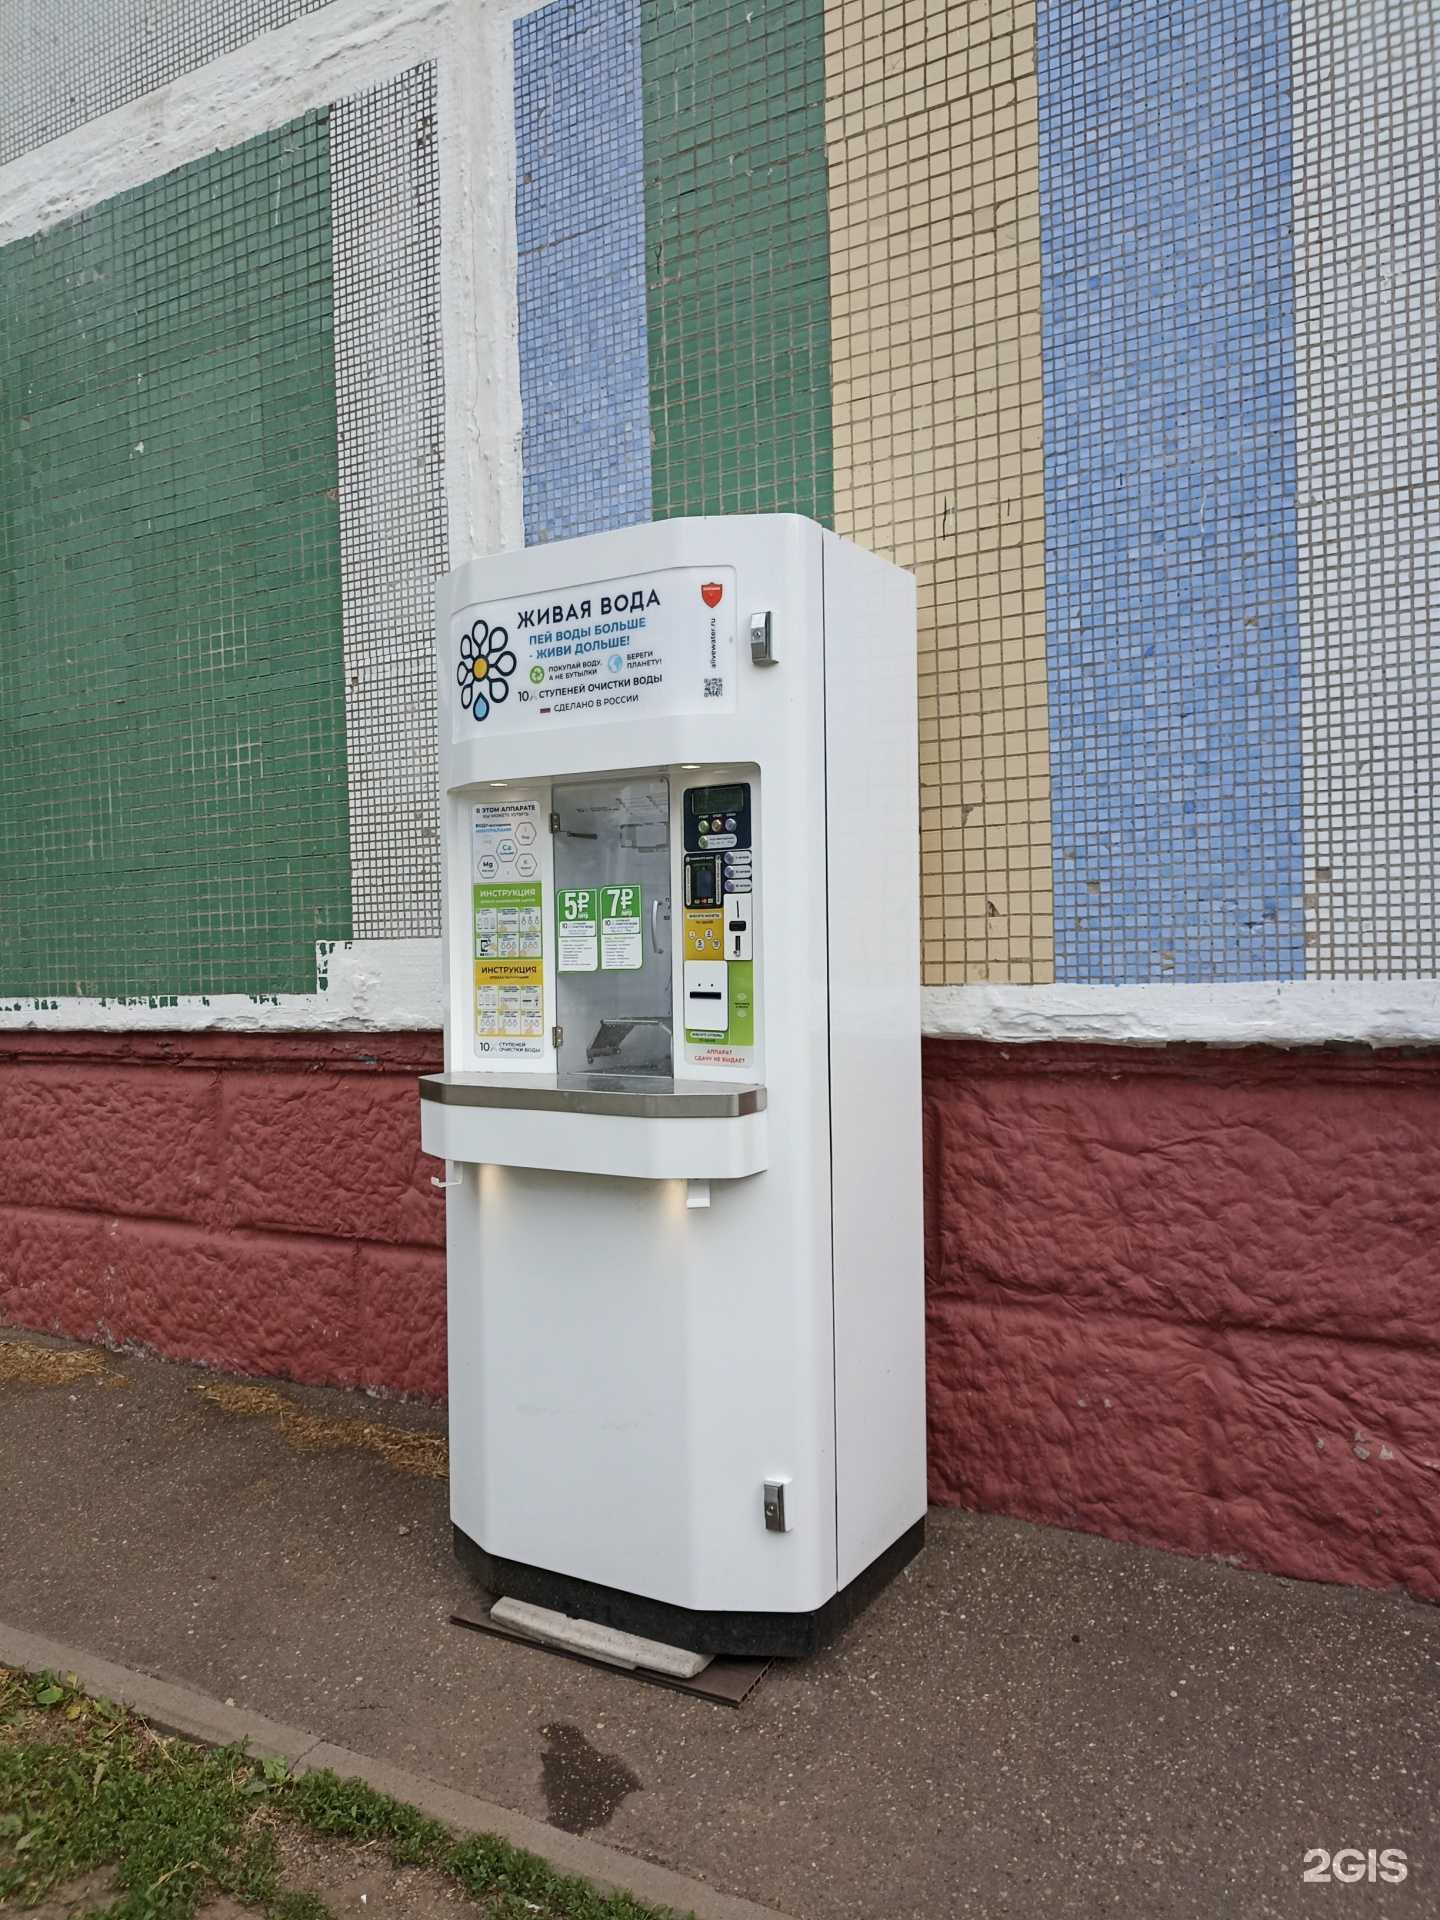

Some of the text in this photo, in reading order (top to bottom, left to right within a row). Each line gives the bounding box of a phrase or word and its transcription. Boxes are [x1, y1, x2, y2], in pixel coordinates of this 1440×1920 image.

[517, 588, 661, 629] ЖИВАЯ ВОДА
[529, 617, 646, 645] ПЕЙ ВОДЫ БОЛЬШЕ
[536, 645, 572, 659] ЖИВИ
[575, 635, 630, 655] ДОЛЬШЕ!
[627, 651, 653, 660] БЕРЕГИ
[549, 662, 580, 673] ПОКУПАЙ
[627, 659, 662, 669] ПЛАНЕТУ!
[565, 669, 598, 679] БУТЫЛКИ
[517, 674, 663, 702] 10 СТУПЕНЕЙ ОЧИСТКИ ВОДЫ
[554, 694, 639, 712] СДЕЛАНО В РОССИИ
[480, 889, 536, 897] ИНСТРУКЦИЯ
[481, 966, 537, 974] ИНСТРУКЦИЯ
